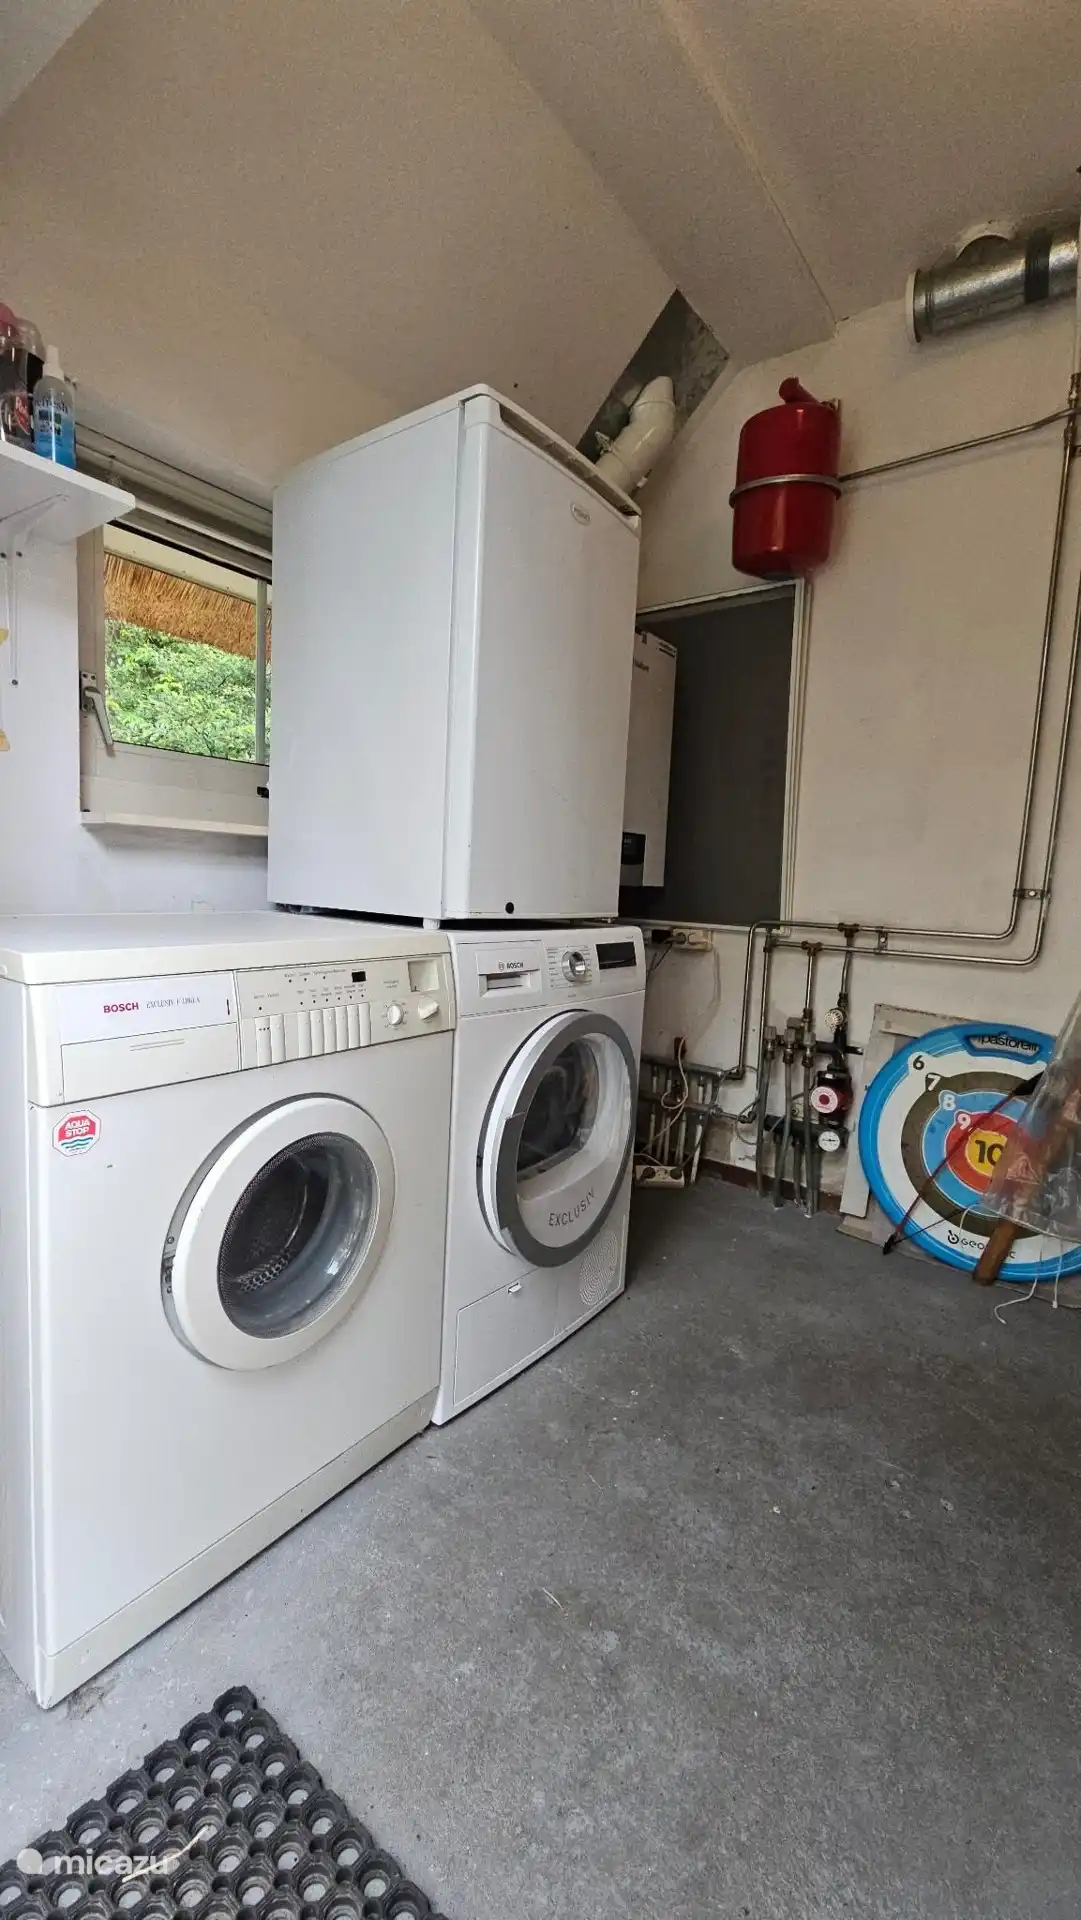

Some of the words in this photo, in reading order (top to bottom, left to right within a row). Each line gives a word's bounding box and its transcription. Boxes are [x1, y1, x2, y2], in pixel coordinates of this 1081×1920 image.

[506, 961, 524, 969] BOSCH
[103, 1002, 139, 1014] BOSCH
[912, 1055, 925, 1071] 6
[926, 1075, 941, 1091] 7
[942, 1094, 956, 1111] 8
[65, 1119, 91, 1130] AQUA
[957, 1113, 971, 1130] 9
[65, 1126, 90, 1138] STOP
[974, 1139, 1005, 1167] 10
[548, 1187, 595, 1227] EXCLUSIV
